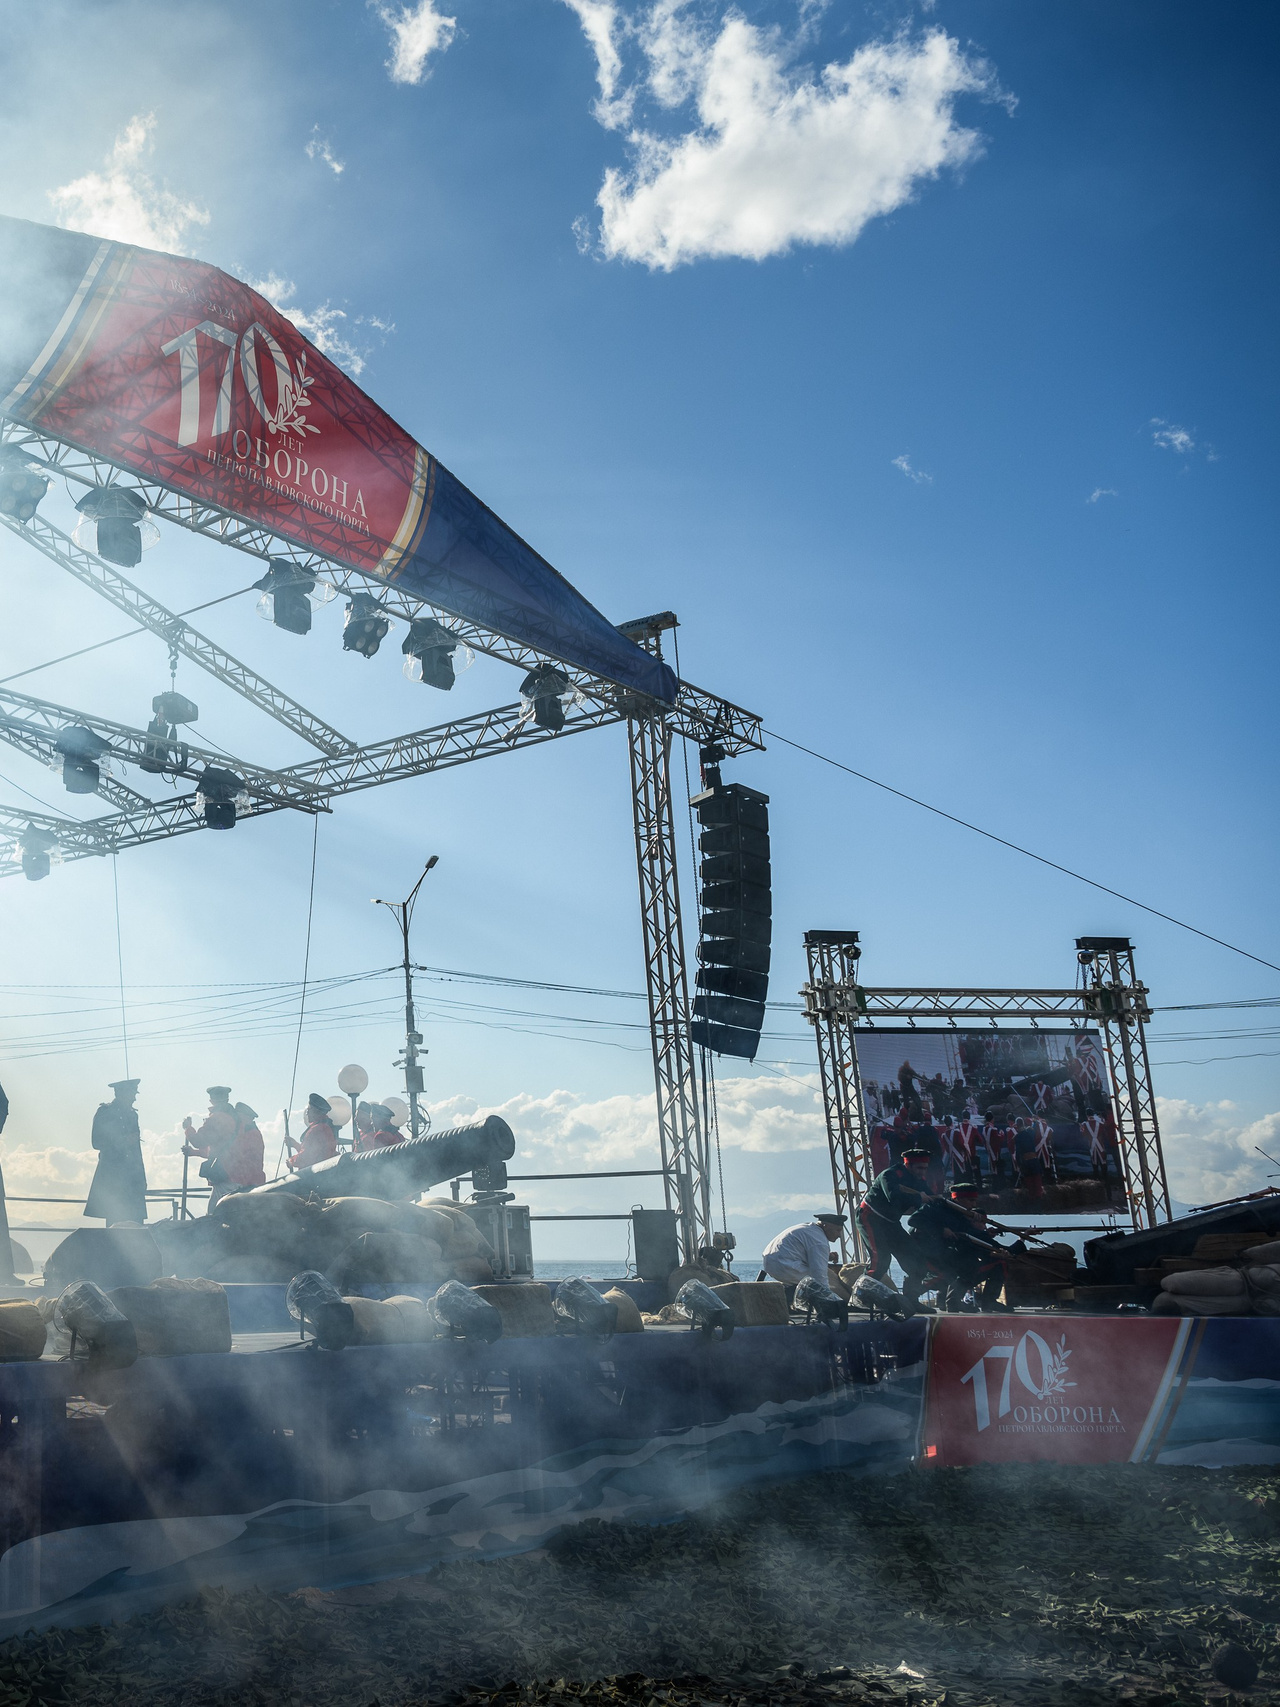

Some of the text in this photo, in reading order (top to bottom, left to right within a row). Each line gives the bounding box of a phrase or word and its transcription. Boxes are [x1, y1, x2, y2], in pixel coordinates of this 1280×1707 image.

[160, 320, 299, 449] 170
[277, 432, 305, 455] ЛЕТ
[207, 448, 371, 538] ПЕТРОПАВЛОВСКОГО ПОРТА
[232, 429, 368, 519] ОБОРОНА
[959, 1329, 1054, 1433] 170
[1045, 1396, 1065, 1405] ЛЕТ
[1013, 1405, 1122, 1424] ОБОРОНА
[1095, 1423, 1127, 1434] ПОРТА
